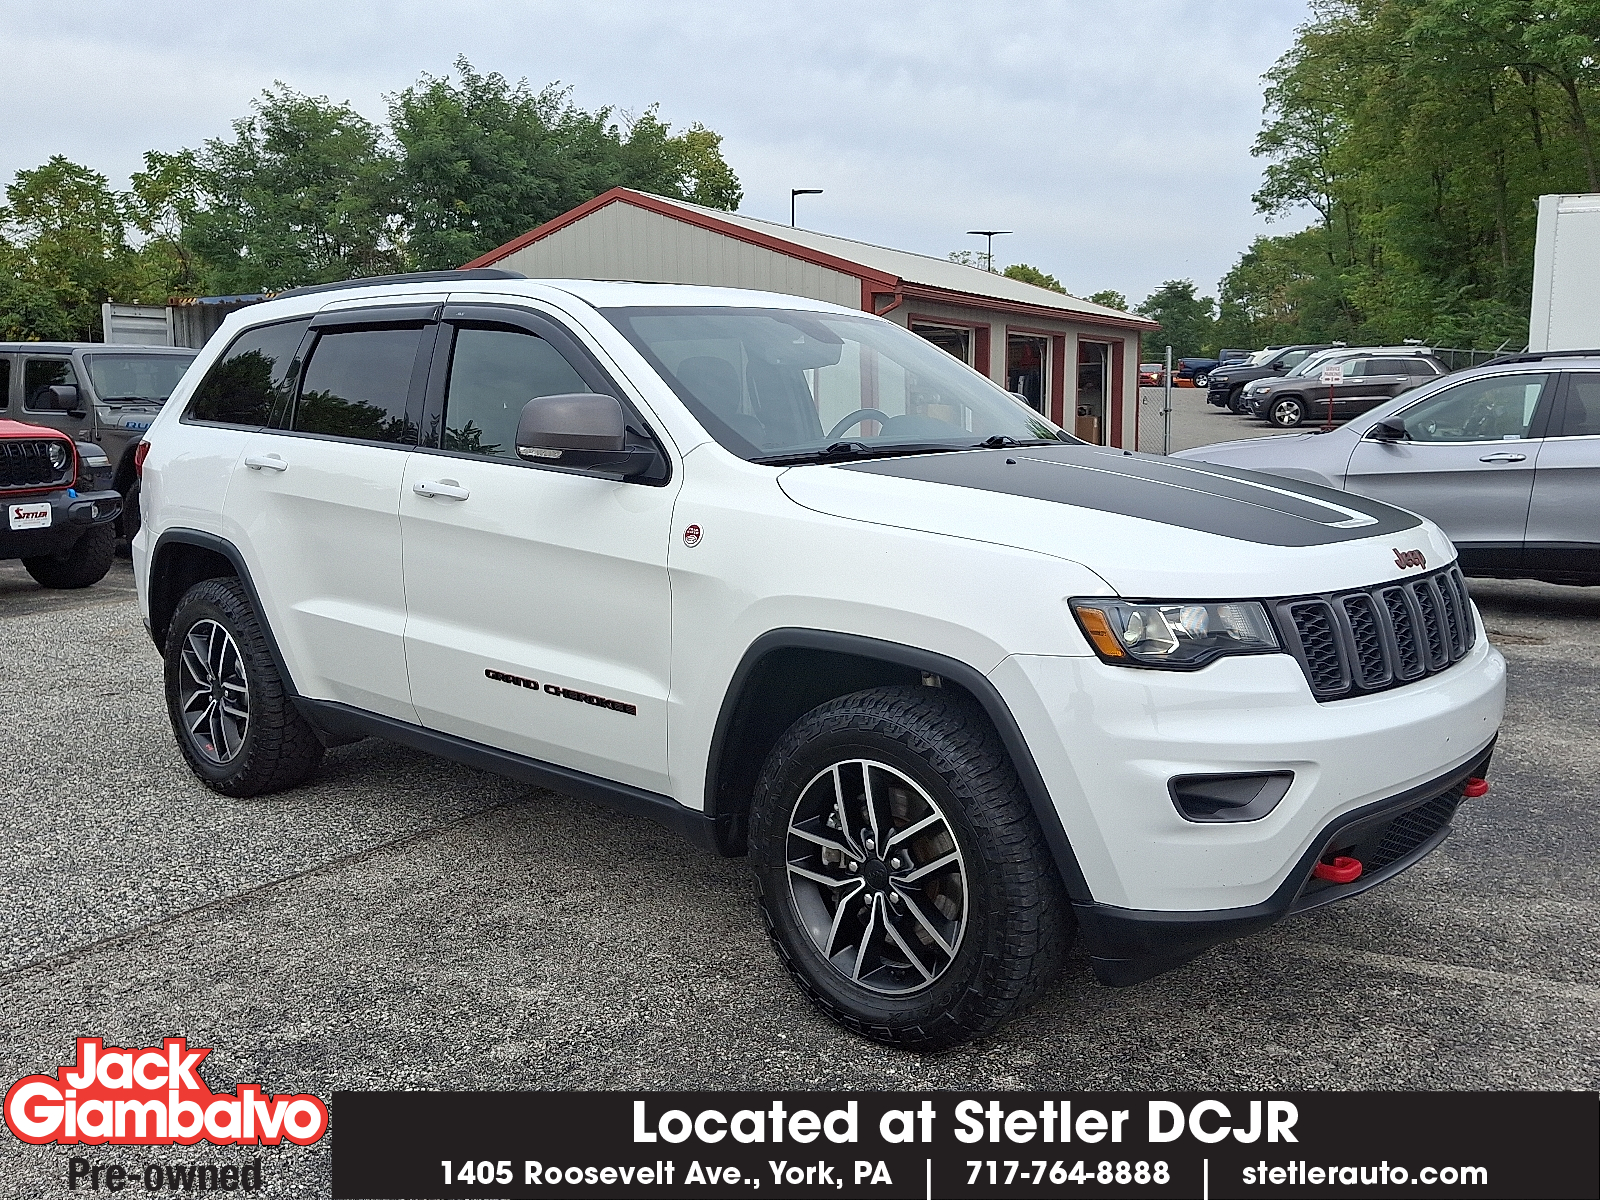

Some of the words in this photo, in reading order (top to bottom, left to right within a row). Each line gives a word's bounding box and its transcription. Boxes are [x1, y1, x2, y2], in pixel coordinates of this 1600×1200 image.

[125, 421, 152, 430] RU
[1391, 547, 1427, 570] Jeep
[484, 668, 540, 691] GRAND
[543, 683, 637, 717] CHEROKEE
